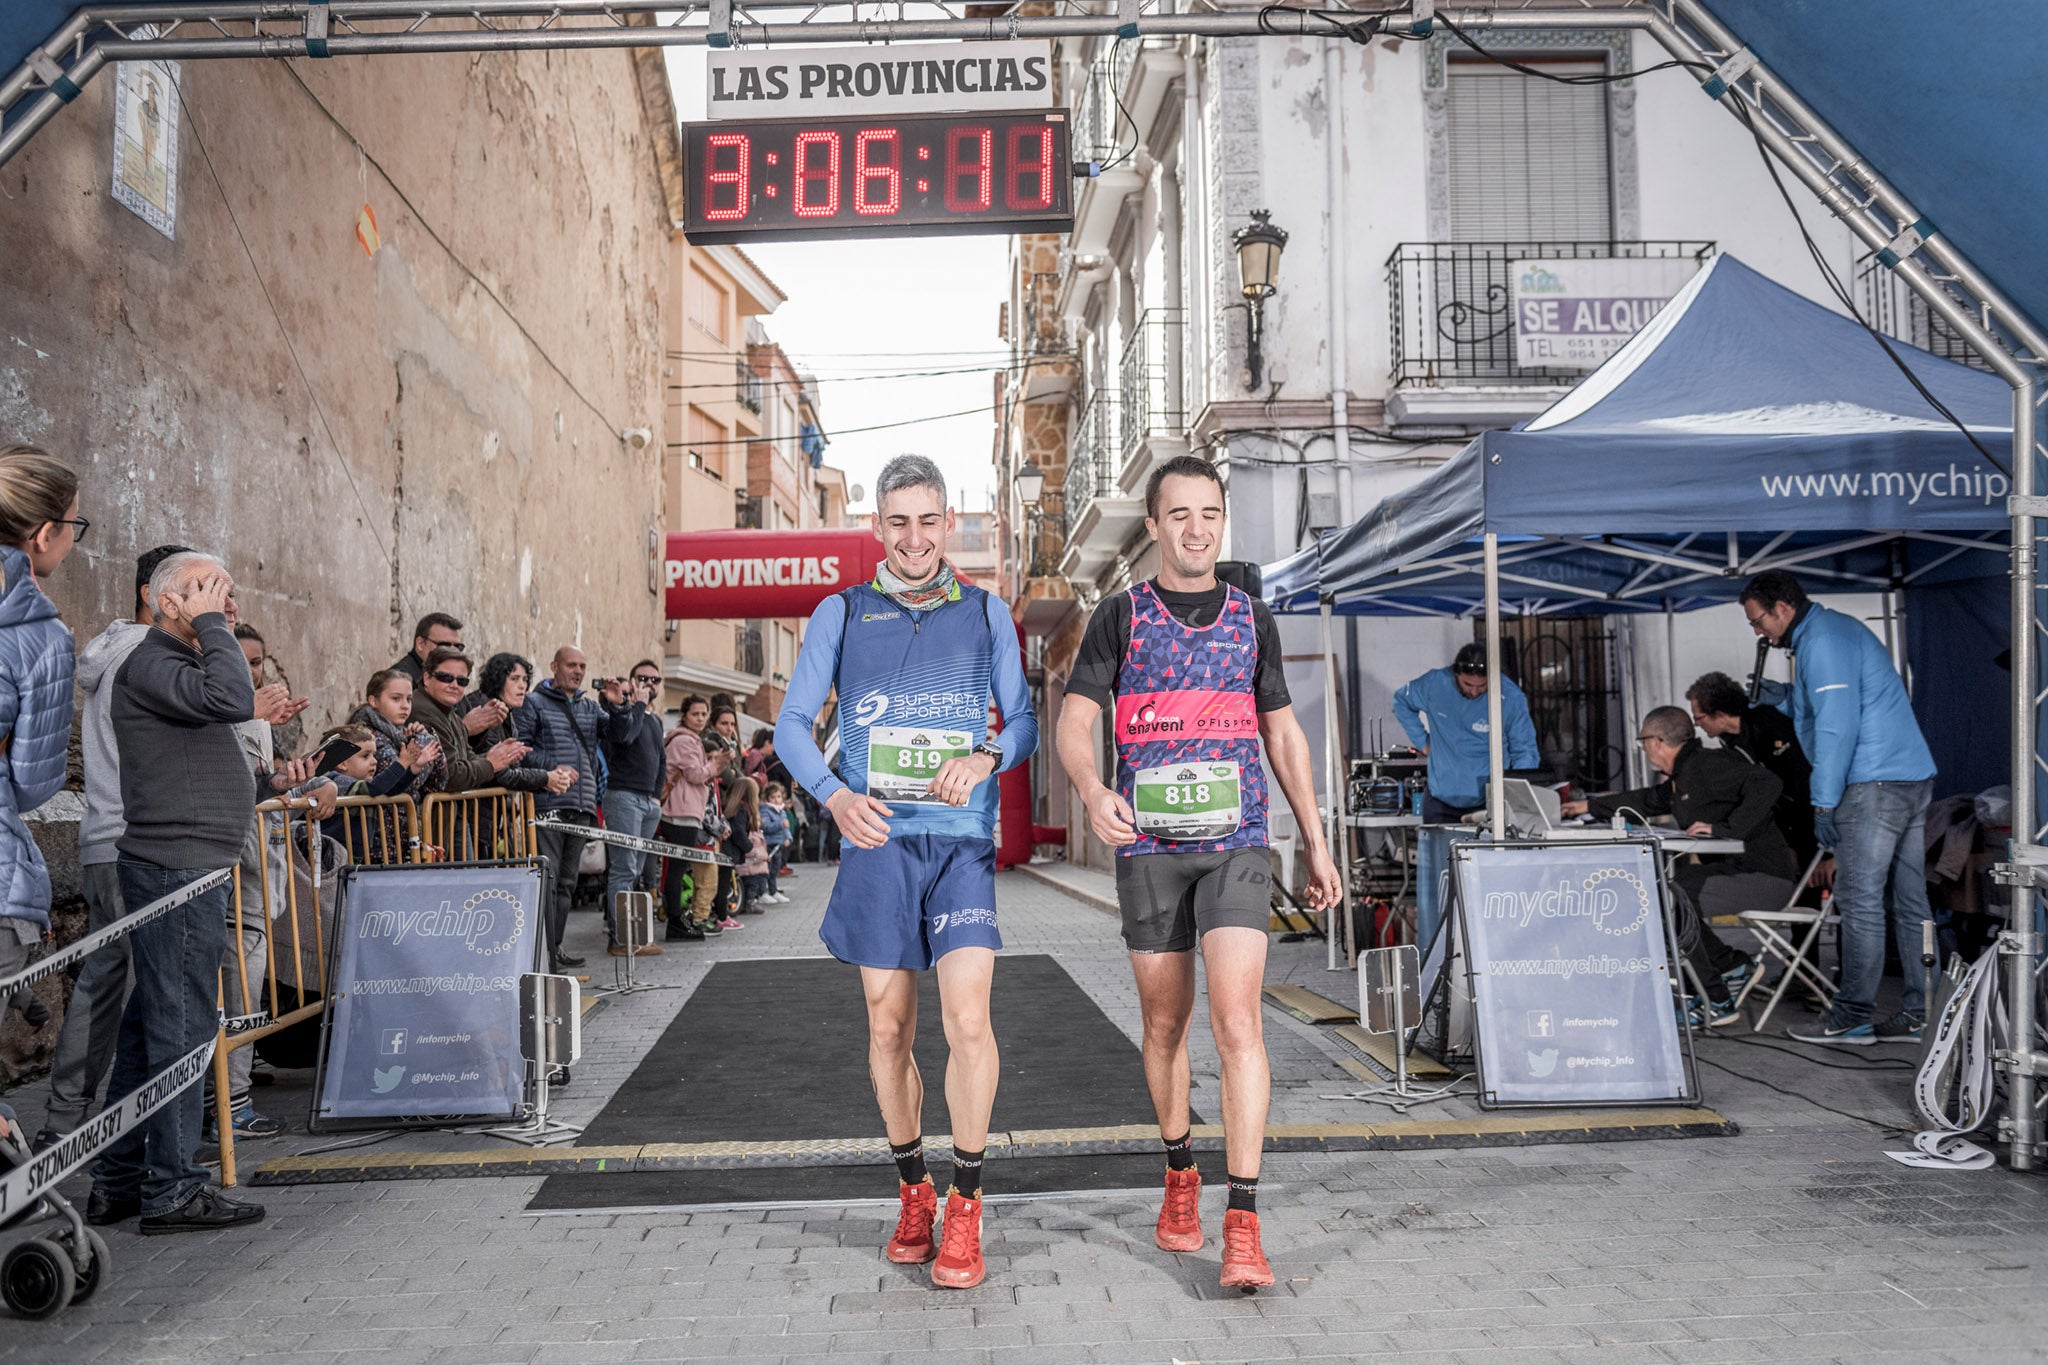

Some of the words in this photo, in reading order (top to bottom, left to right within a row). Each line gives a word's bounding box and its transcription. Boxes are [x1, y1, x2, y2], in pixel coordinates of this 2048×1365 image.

[712, 65, 789, 101] LAS
[799, 56, 1047, 99] PROVINCIAS
[705, 127, 1053, 221] 3:06:11
[1523, 302, 1560, 332] SE
[664, 556, 840, 588] PROVINCIAS
[894, 692, 980, 708] SUPERATE
[897, 749, 942, 770] 819
[1165, 784, 1211, 805] 818
[1484, 879, 1618, 927] mychip
[359, 900, 495, 945] mychip
[1488, 954, 1652, 980] www.mychip.es
[353, 972, 516, 997] www.mychip.es
[1562, 1016, 1620, 1028] /infomychip
[416, 1032, 472, 1045] /infomychip
[1566, 1055, 1636, 1069] @Mychip_Info
[136, 1059, 190, 1119] PROVINCIAS
[411, 1071, 480, 1086] @Mychip_Info
[101, 1105, 124, 1143] LAS
[28, 1119, 101, 1196] PROVINCIAS
